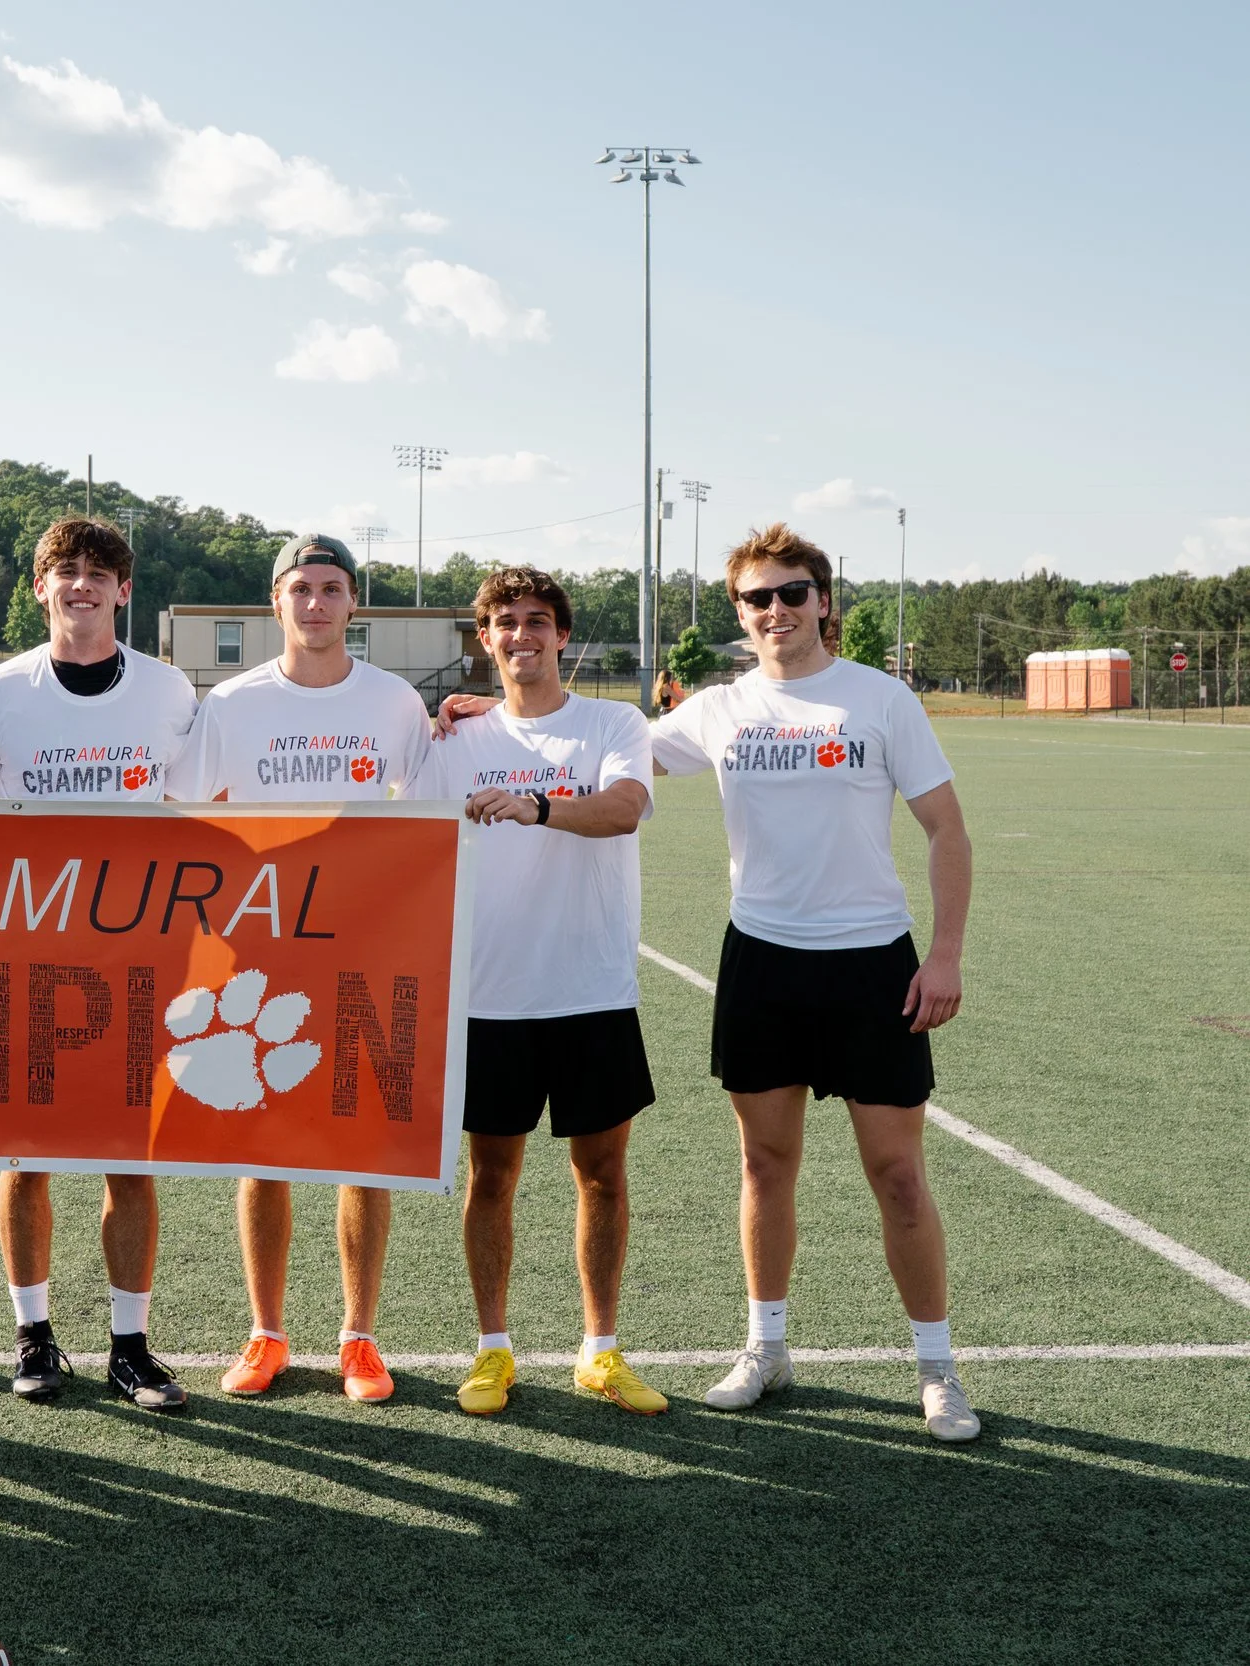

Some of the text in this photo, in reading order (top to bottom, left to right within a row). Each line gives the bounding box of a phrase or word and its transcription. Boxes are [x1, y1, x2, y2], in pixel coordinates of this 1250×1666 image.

[736, 723, 848, 740] INTRAMURAL
[269, 736, 379, 752] INTRAMURAL
[33, 745, 152, 765] INTRAMURAL
[724, 740, 865, 771] CHAMPIN
[257, 755, 387, 785] CHAMPIN
[22, 763, 162, 794] CHAMPIN
[473, 766, 578, 786] INTRAMURAL
[29, 963, 56, 971] TENNIS
[29, 971, 67, 979] VOLLEYBALL
[68, 972, 102, 981] FRISBEE
[338, 972, 364, 980] EFFORT
[128, 979, 155, 990] FLAG
[393, 989, 418, 1000] FLAG
[29, 1003, 55, 1011] TENNIS
[86, 1015, 112, 1023] TENNIS
[336, 1009, 378, 1019] SPIKEBALL
[335, 1017, 350, 1025] FUN
[391, 1022, 416, 1031] EFFORT
[55, 1027, 104, 1040] RESPECT
[128, 1026, 154, 1034] TENNIS
[348, 1019, 359, 1071] VOLLEYBALL
[365, 1040, 387, 1048] TENNIS
[391, 1036, 416, 1045] TENNIS
[127, 1053, 152, 1061] FRISBEE
[371, 1059, 415, 1068] DETERMINATION
[28, 1066, 55, 1080] FUN
[373, 1065, 412, 1077] SOFTBALL
[127, 1067, 135, 1106] WATER POLO
[135, 1067, 144, 1106] TEAMWORK
[333, 1078, 358, 1089] FLAG
[378, 1080, 413, 1092] EFFORT
[382, 1094, 412, 1105] FRISBEE
[388, 1114, 412, 1122] SOCCER
